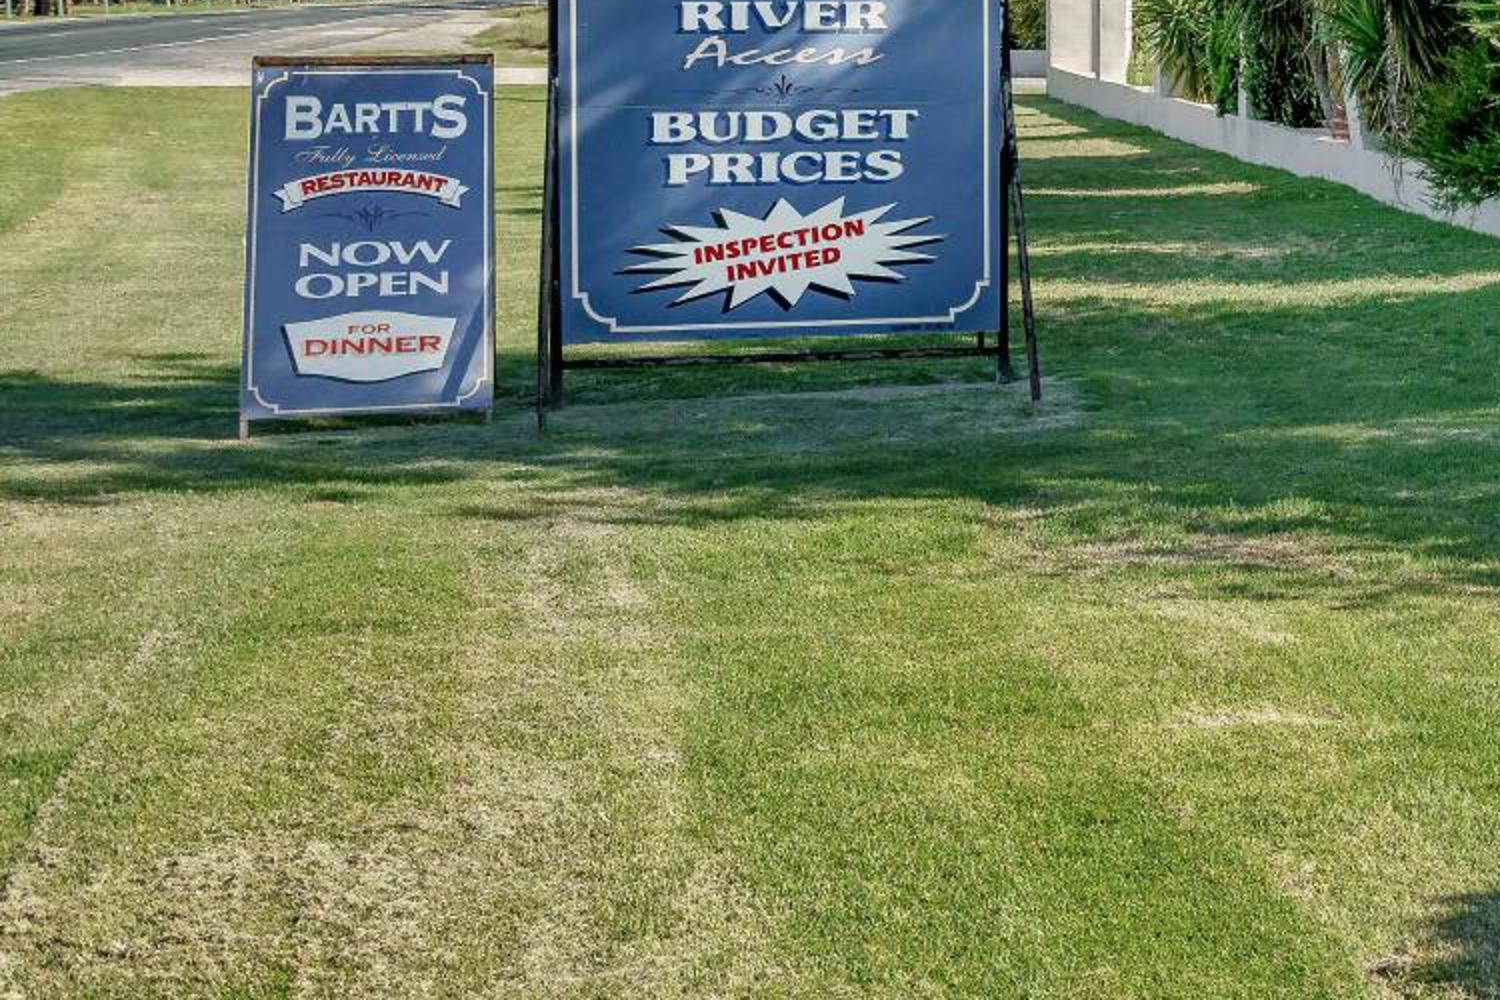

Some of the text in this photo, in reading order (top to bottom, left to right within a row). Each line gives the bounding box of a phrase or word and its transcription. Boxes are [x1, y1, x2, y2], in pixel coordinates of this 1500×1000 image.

[678, 0, 888, 33] RIVER
[683, 35, 883, 70] Access
[650, 109, 918, 144] BUDGET
[297, 143, 447, 169] Fully Licensed
[665, 150, 904, 186] PRICES
[301, 171, 448, 195] RESTAURANT
[300, 239, 452, 267] NOW
[694, 219, 865, 265] INSPECTION
[726, 247, 841, 282] INVITED
[295, 271, 449, 298] OPEN
[348, 323, 391, 335] FOR
[304, 336, 441, 357] DINNER
